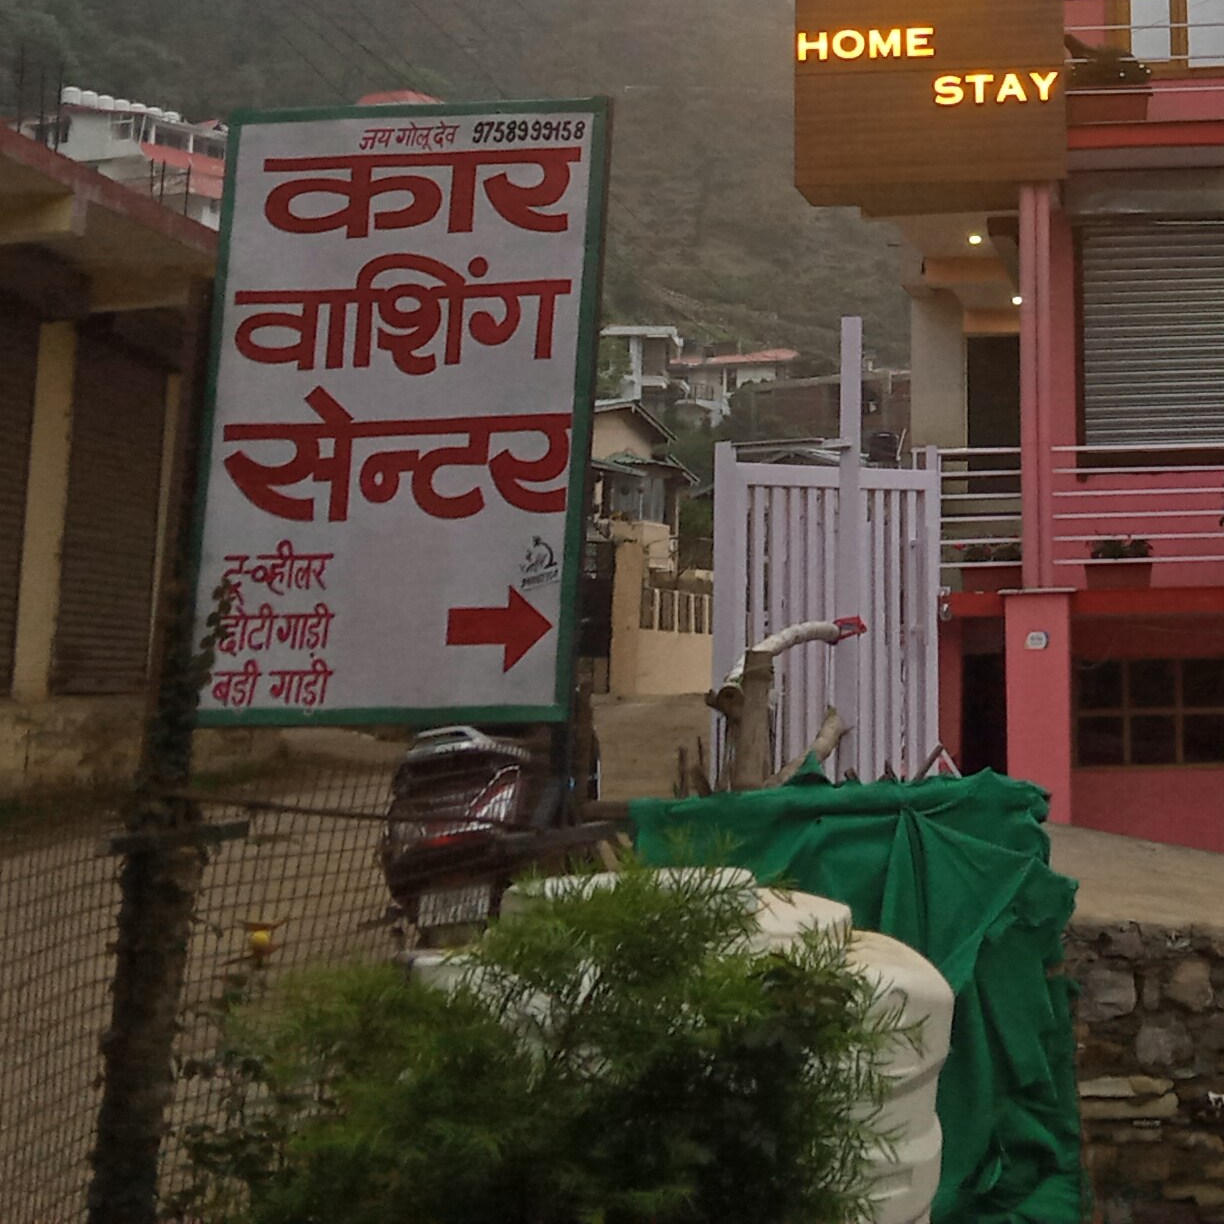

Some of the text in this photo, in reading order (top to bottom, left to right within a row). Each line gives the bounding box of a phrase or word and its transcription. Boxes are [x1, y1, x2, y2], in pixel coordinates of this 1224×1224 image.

[797, 27, 934, 61] HOME
[933, 71, 1058, 105] STAY
[359, 128, 395, 150] जय
[472, 120, 586, 143] 9758999158
[264, 147, 581, 238] कार
[235, 253, 571, 376] वाशिंग
[222, 385, 572, 522] सेन्टर
